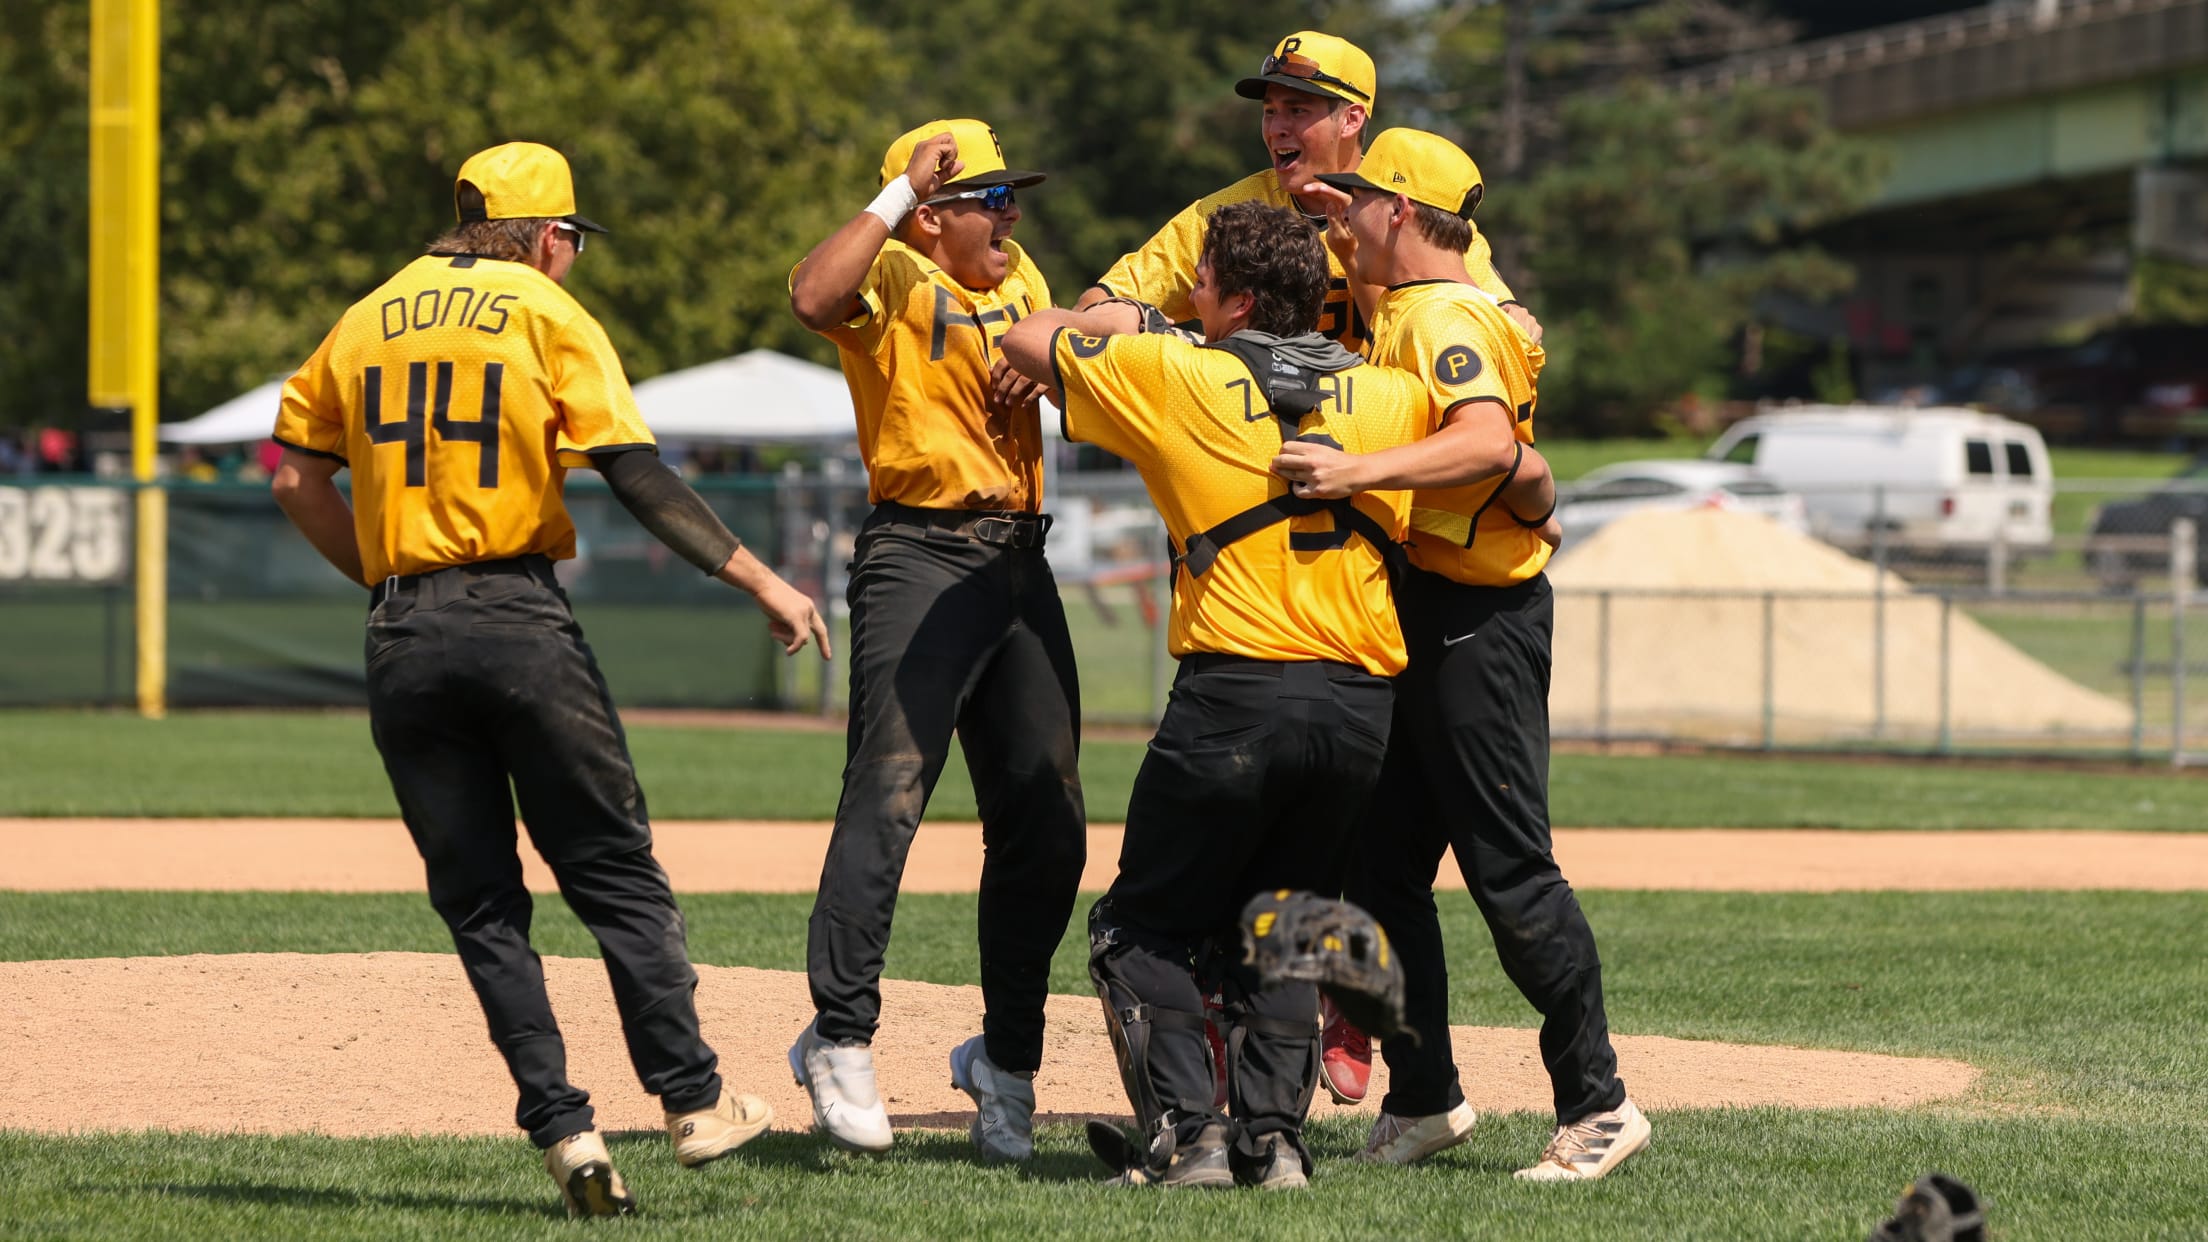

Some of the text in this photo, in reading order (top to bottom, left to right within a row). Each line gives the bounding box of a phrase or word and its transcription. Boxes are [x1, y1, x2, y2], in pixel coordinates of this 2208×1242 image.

[382, 286, 520, 342] DONIS
[1447, 352, 1469, 378] P
[364, 361, 504, 489] 44
[0, 486, 123, 580] 325
